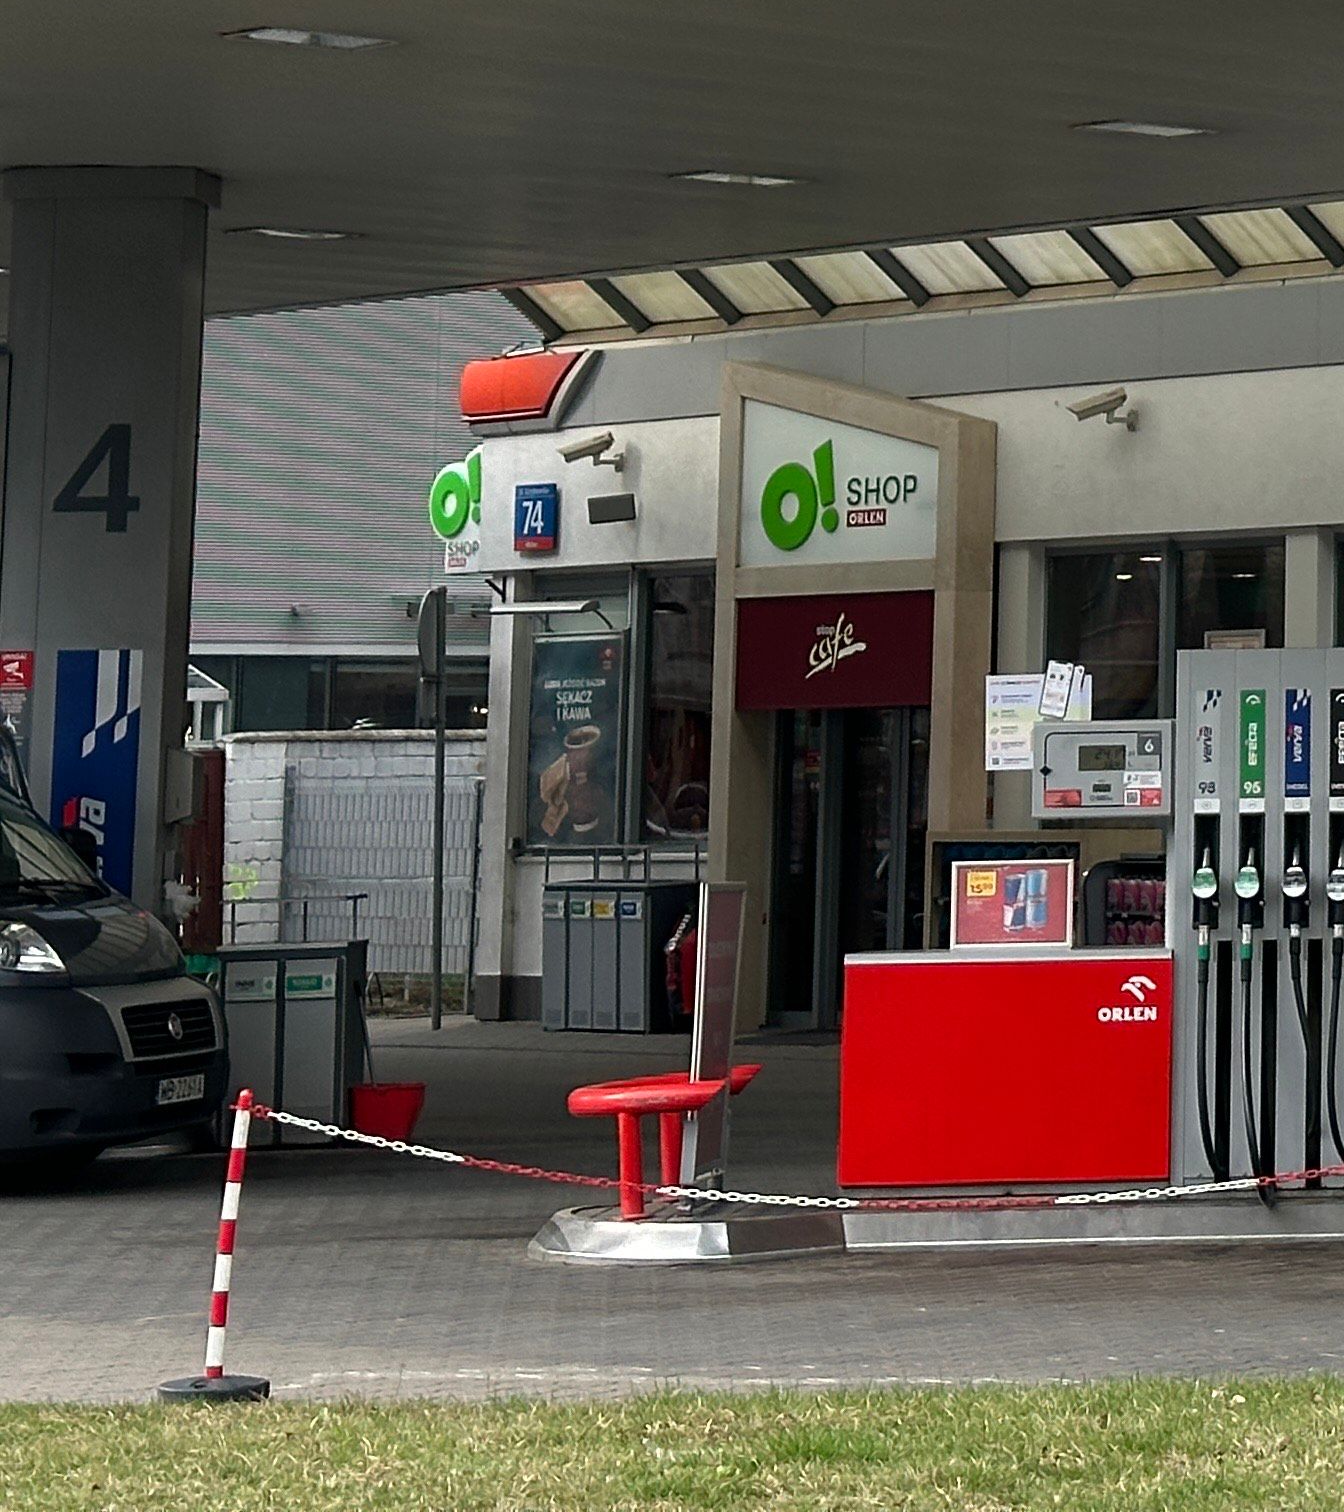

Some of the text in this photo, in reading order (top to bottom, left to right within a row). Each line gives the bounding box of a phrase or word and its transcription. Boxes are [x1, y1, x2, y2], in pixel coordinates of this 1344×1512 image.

[51, 423, 140, 533] 4
[846, 474, 918, 507] SHOP
[522, 500, 544, 535] 74
[849, 510, 884, 526] ORLEN
[447, 540, 480, 557] SHOP
[1144, 739, 1154, 752] 6
[1098, 1007, 1157, 1022] ORLEN
